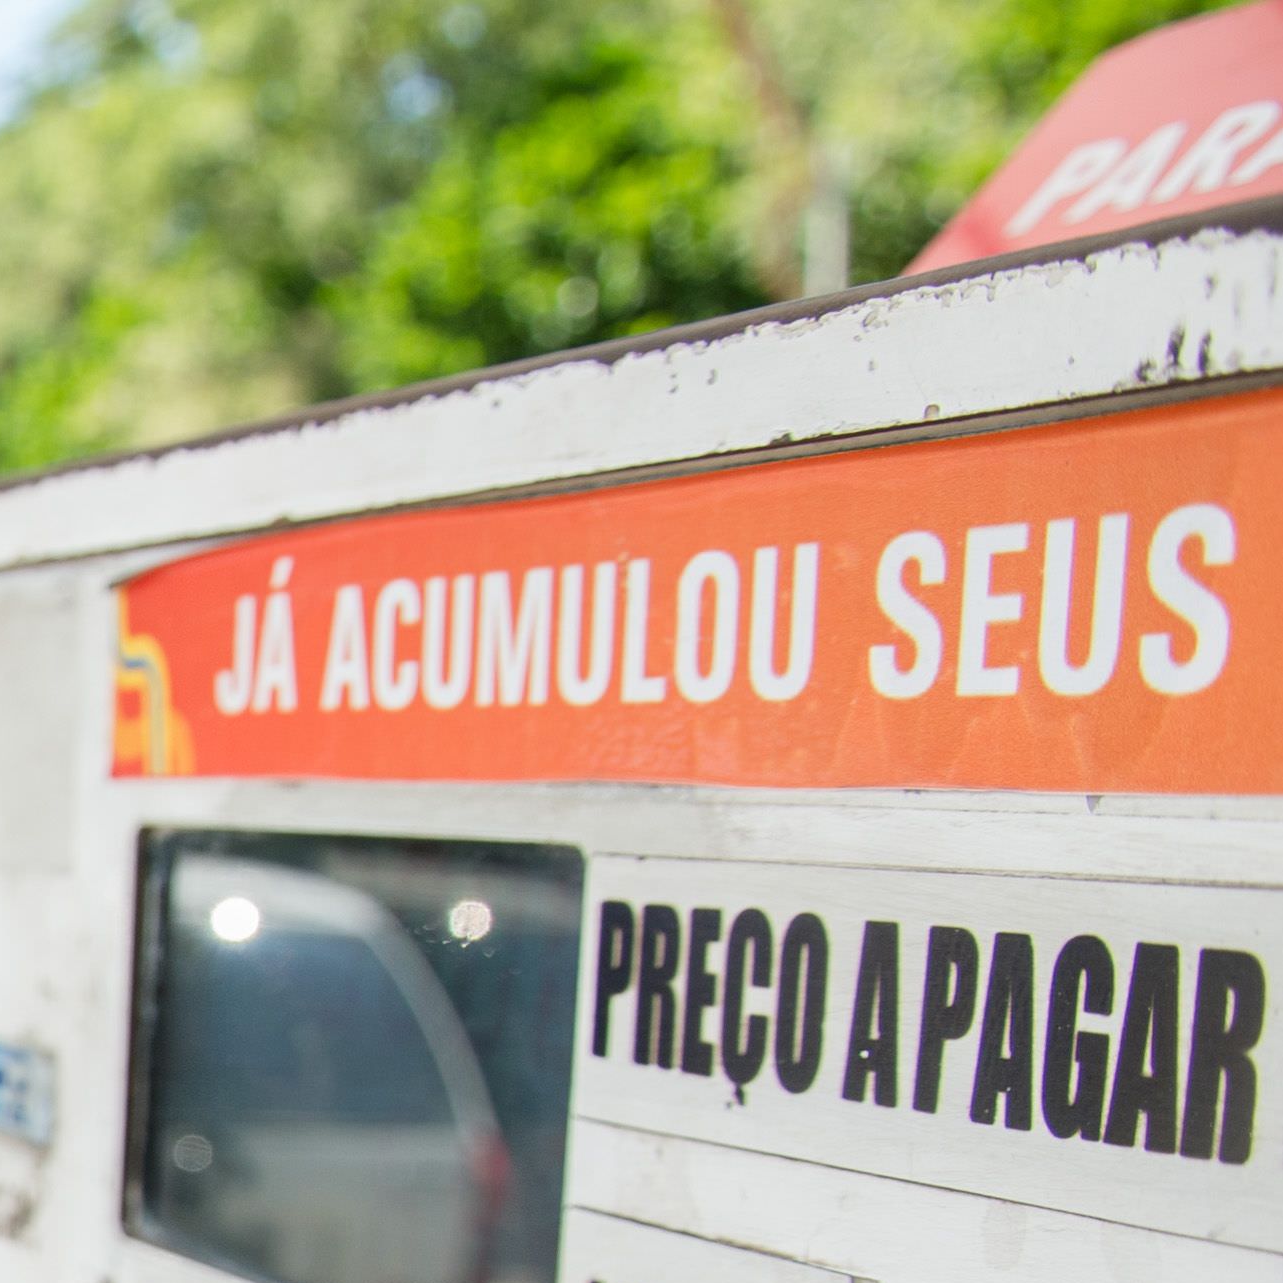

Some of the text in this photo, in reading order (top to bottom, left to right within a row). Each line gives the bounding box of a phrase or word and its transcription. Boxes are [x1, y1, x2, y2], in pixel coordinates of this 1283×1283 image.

[215, 502, 1236, 715] JÁ ACUMULOU SEUS
[591, 899, 1266, 1166] PREÇO A PAGAR
